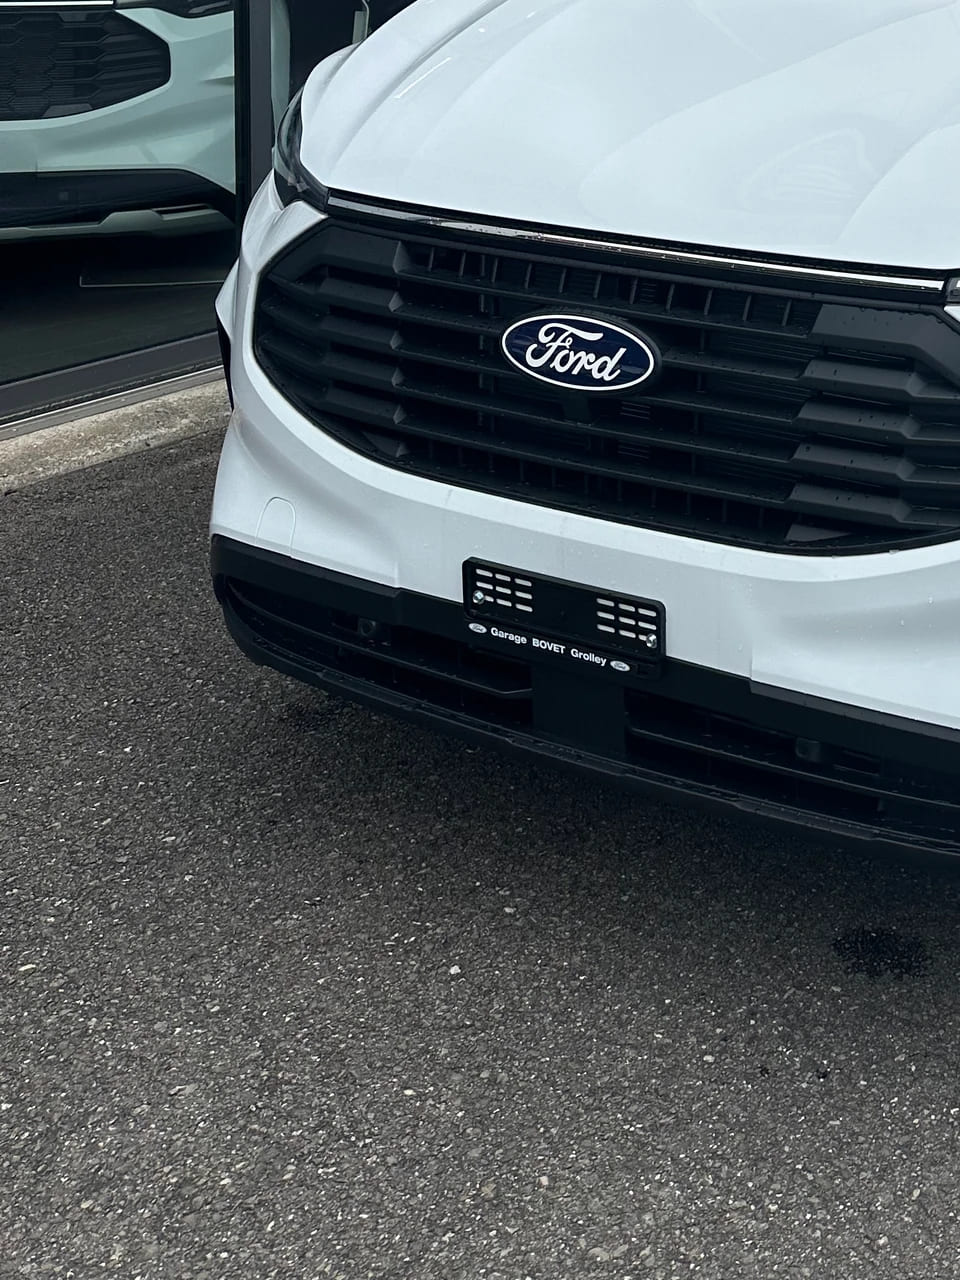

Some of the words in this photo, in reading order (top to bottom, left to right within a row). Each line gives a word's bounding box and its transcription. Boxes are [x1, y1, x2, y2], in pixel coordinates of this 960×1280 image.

[525, 322, 628, 382] Ford
[490, 627, 527, 644] Garage
[532, 637, 566, 654] BOVET
[570, 648, 607, 667] Grolley
